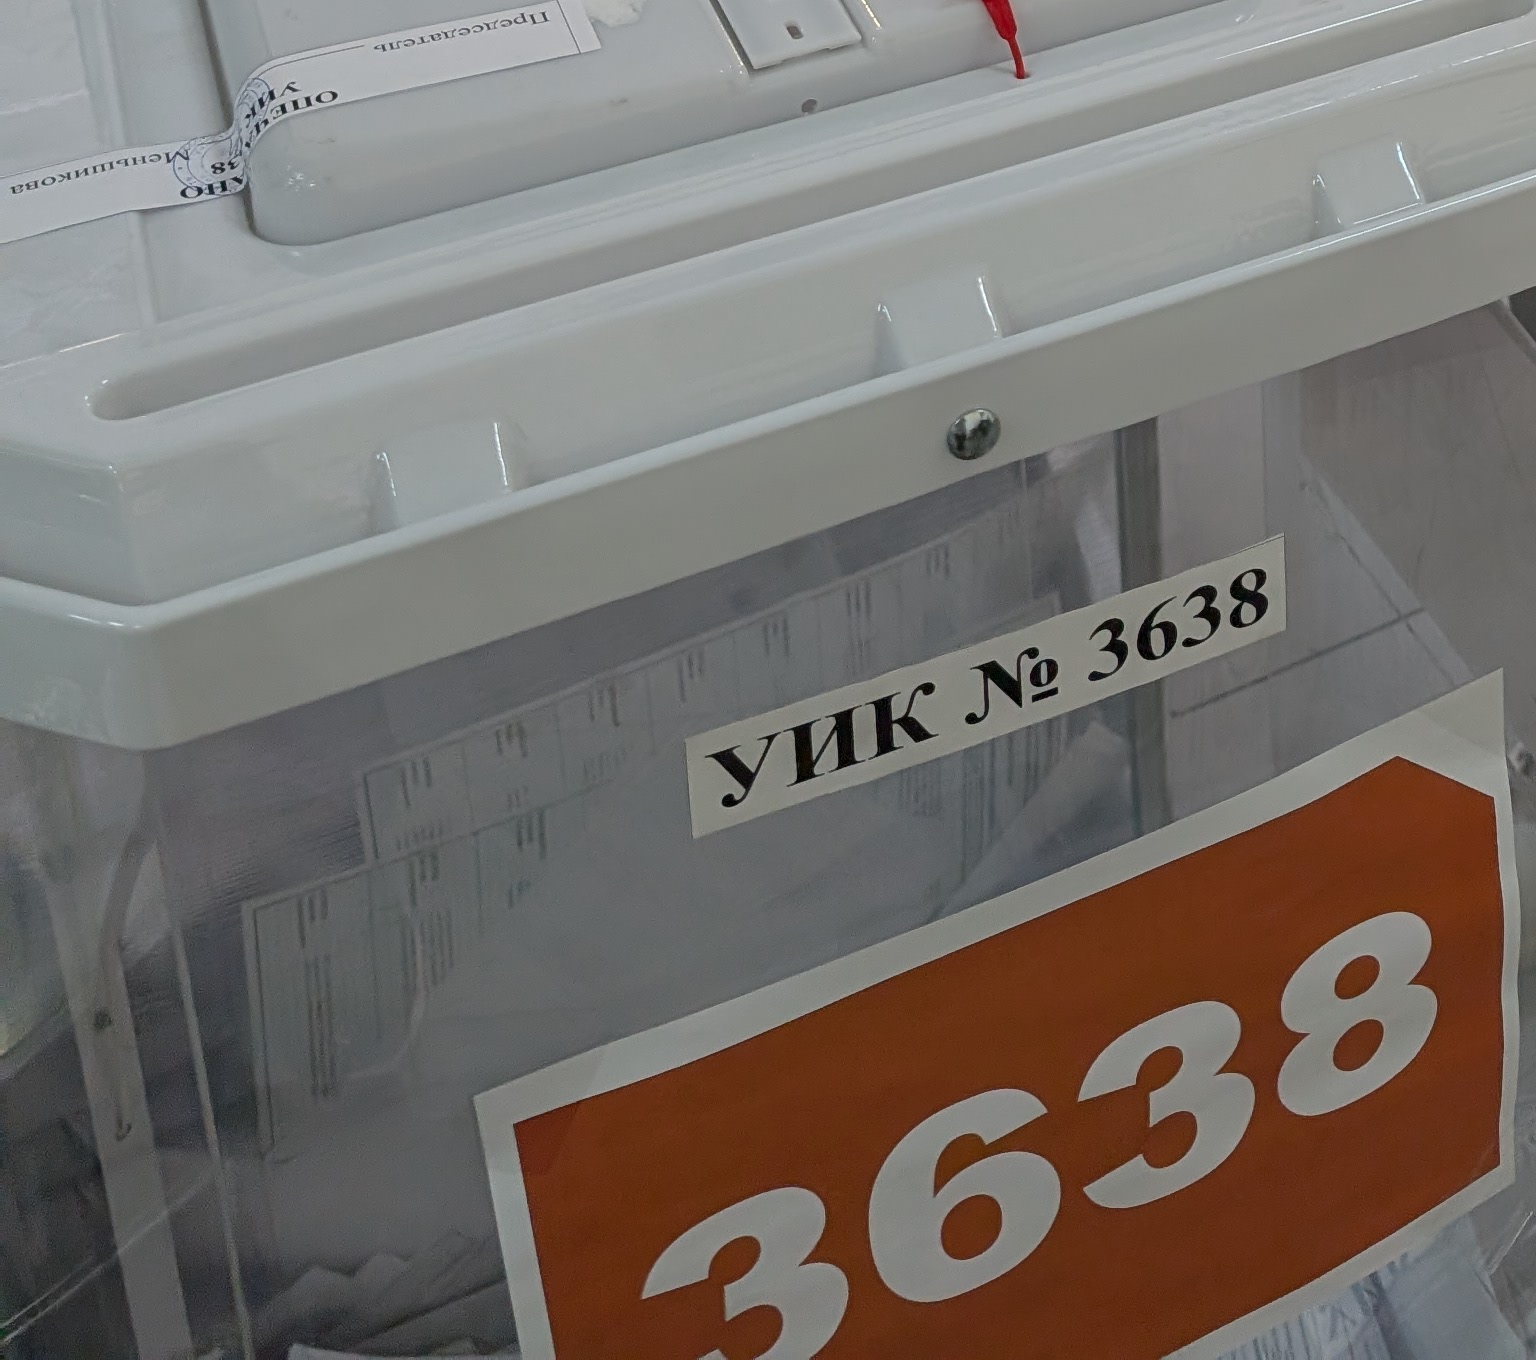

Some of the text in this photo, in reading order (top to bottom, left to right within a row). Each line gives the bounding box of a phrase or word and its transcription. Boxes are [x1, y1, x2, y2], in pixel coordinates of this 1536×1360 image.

[10, 11, 551, 195] Председатель Меньшикова
[704, 681, 940, 808] УИК
[1088, 567, 1268, 682] 3638
[641, 911, 1438, 1360] 3638
